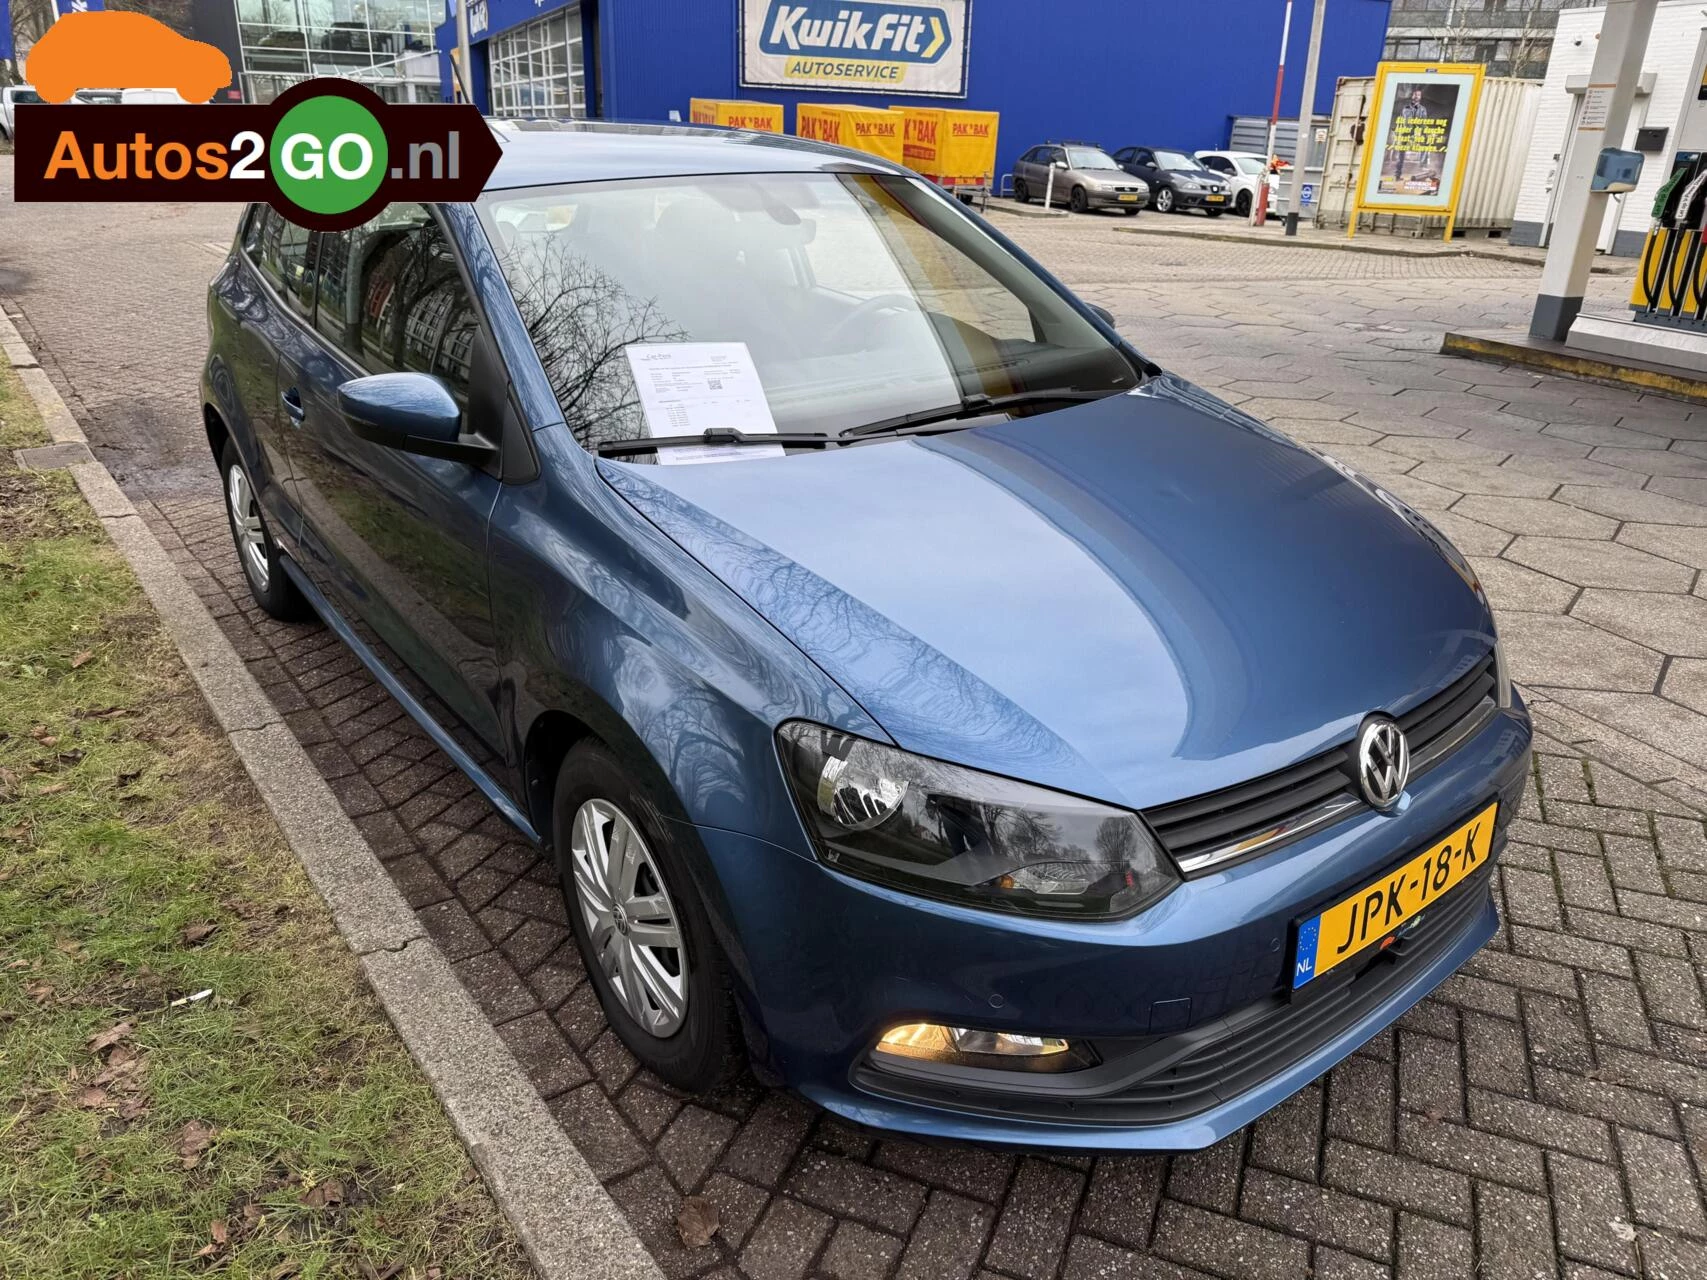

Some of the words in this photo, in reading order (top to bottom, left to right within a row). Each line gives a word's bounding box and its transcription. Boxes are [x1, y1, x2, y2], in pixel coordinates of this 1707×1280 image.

[791, 61, 899, 80] AUTOSERVICE
[729, 116, 746, 129] PAK
[754, 116, 773, 129] BAK
[856, 122, 872, 135] PAK
[878, 123, 895, 135] BAK
[952, 123, 968, 135] PAK
[973, 123, 989, 136] BAK
[917, 120, 938, 145] BAK
[1336, 822, 1481, 954] JPK-18-K
[1296, 957, 1312, 976] NL
